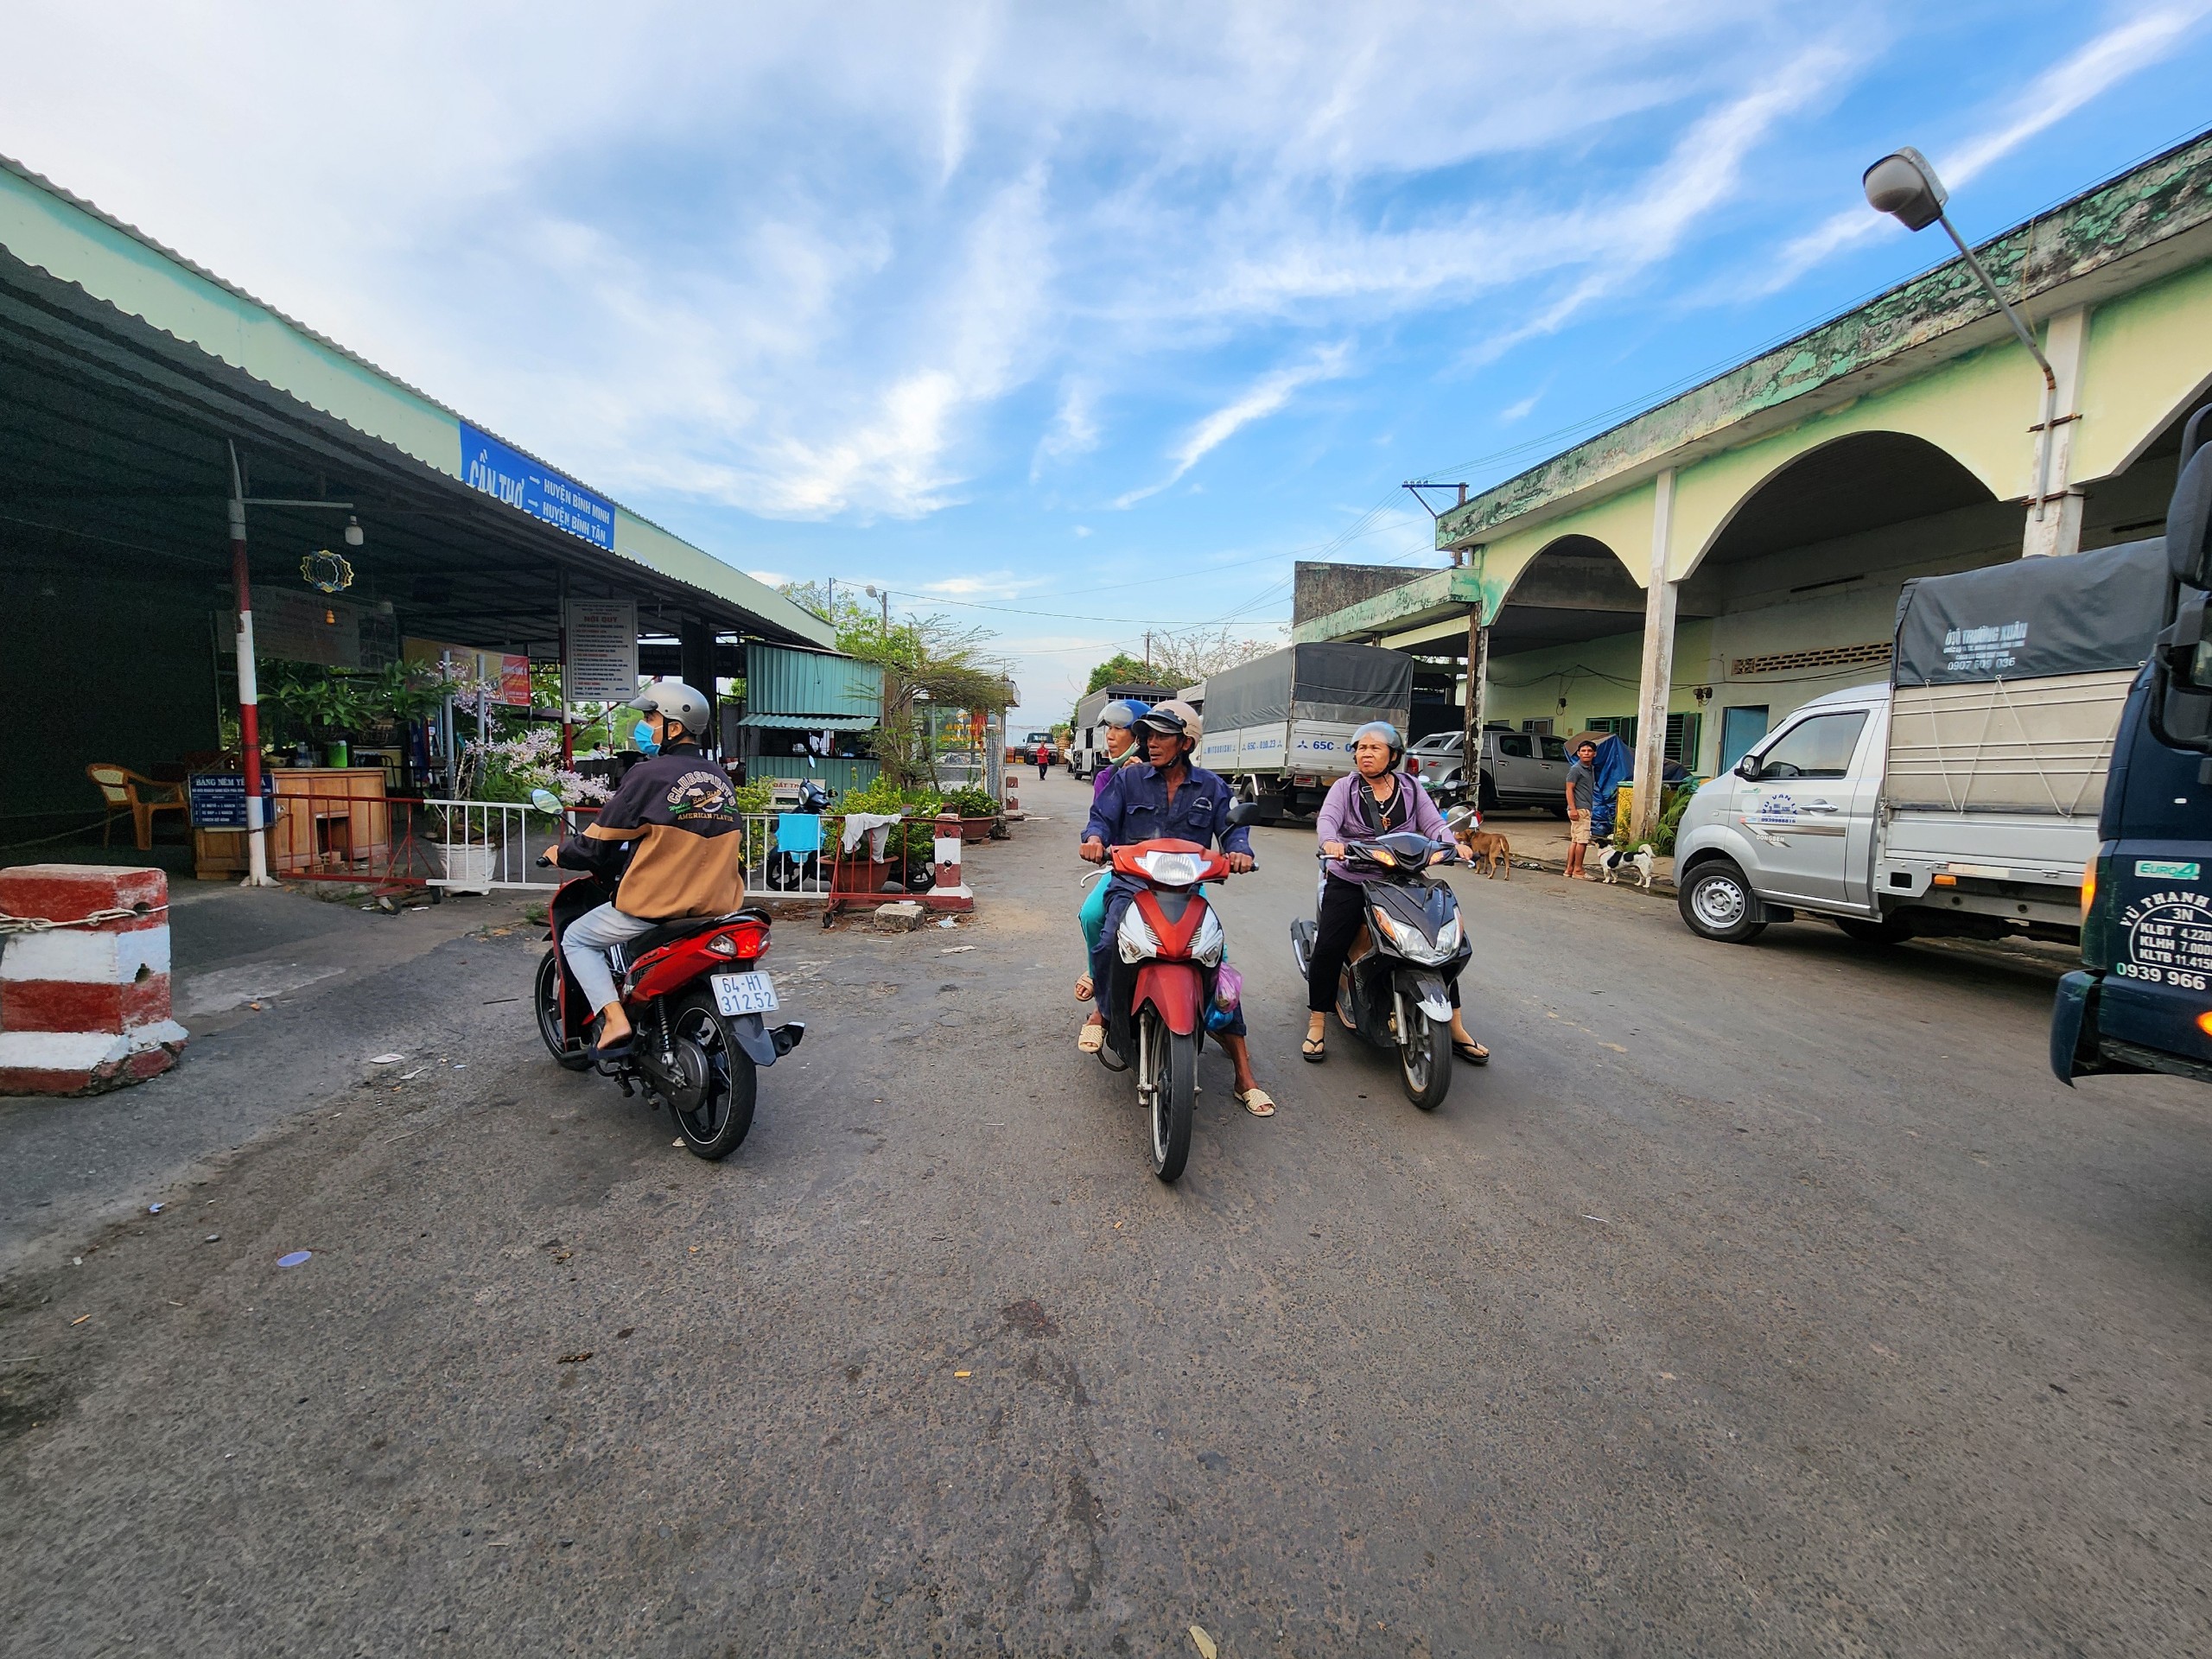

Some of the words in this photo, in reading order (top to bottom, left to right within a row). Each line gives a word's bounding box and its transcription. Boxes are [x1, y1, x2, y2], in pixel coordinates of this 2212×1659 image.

[543, 478, 571, 505] HUYỆN
[573, 492, 591, 515] BÌNH
[592, 503, 610, 524] MINH
[543, 501, 570, 527] HUYỆN
[571, 512, 589, 536] BÌNH
[591, 524, 606, 543] TÂN
[1999, 620, 2029, 641] XUÂN
[1948, 660, 1972, 671] 0907
[1995, 657, 2016, 668] 036
[1247, 741, 1256, 750] 65C
[1259, 740, 1276, 749] 010.23
[1313, 741, 1334, 751] 65C
[1345, 743, 1355, 753] 0
[677, 812, 713, 821] AMERICAN
[2140, 891, 2210, 908] THANH
[2172, 908, 2194, 921] 3N
[2139, 922, 2175, 937] KLBT
[2180, 928, 2212, 942] 4.220
[2139, 935, 2175, 950] KLHH
[2179, 941, 2212, 956] 7.000
[2139, 948, 2172, 963] KLTB
[721, 975, 762, 994] 64-H1
[2117, 962, 2162, 982] 0939
[2167, 971, 2206, 991] 966
[721, 991, 774, 1013] 312.52
